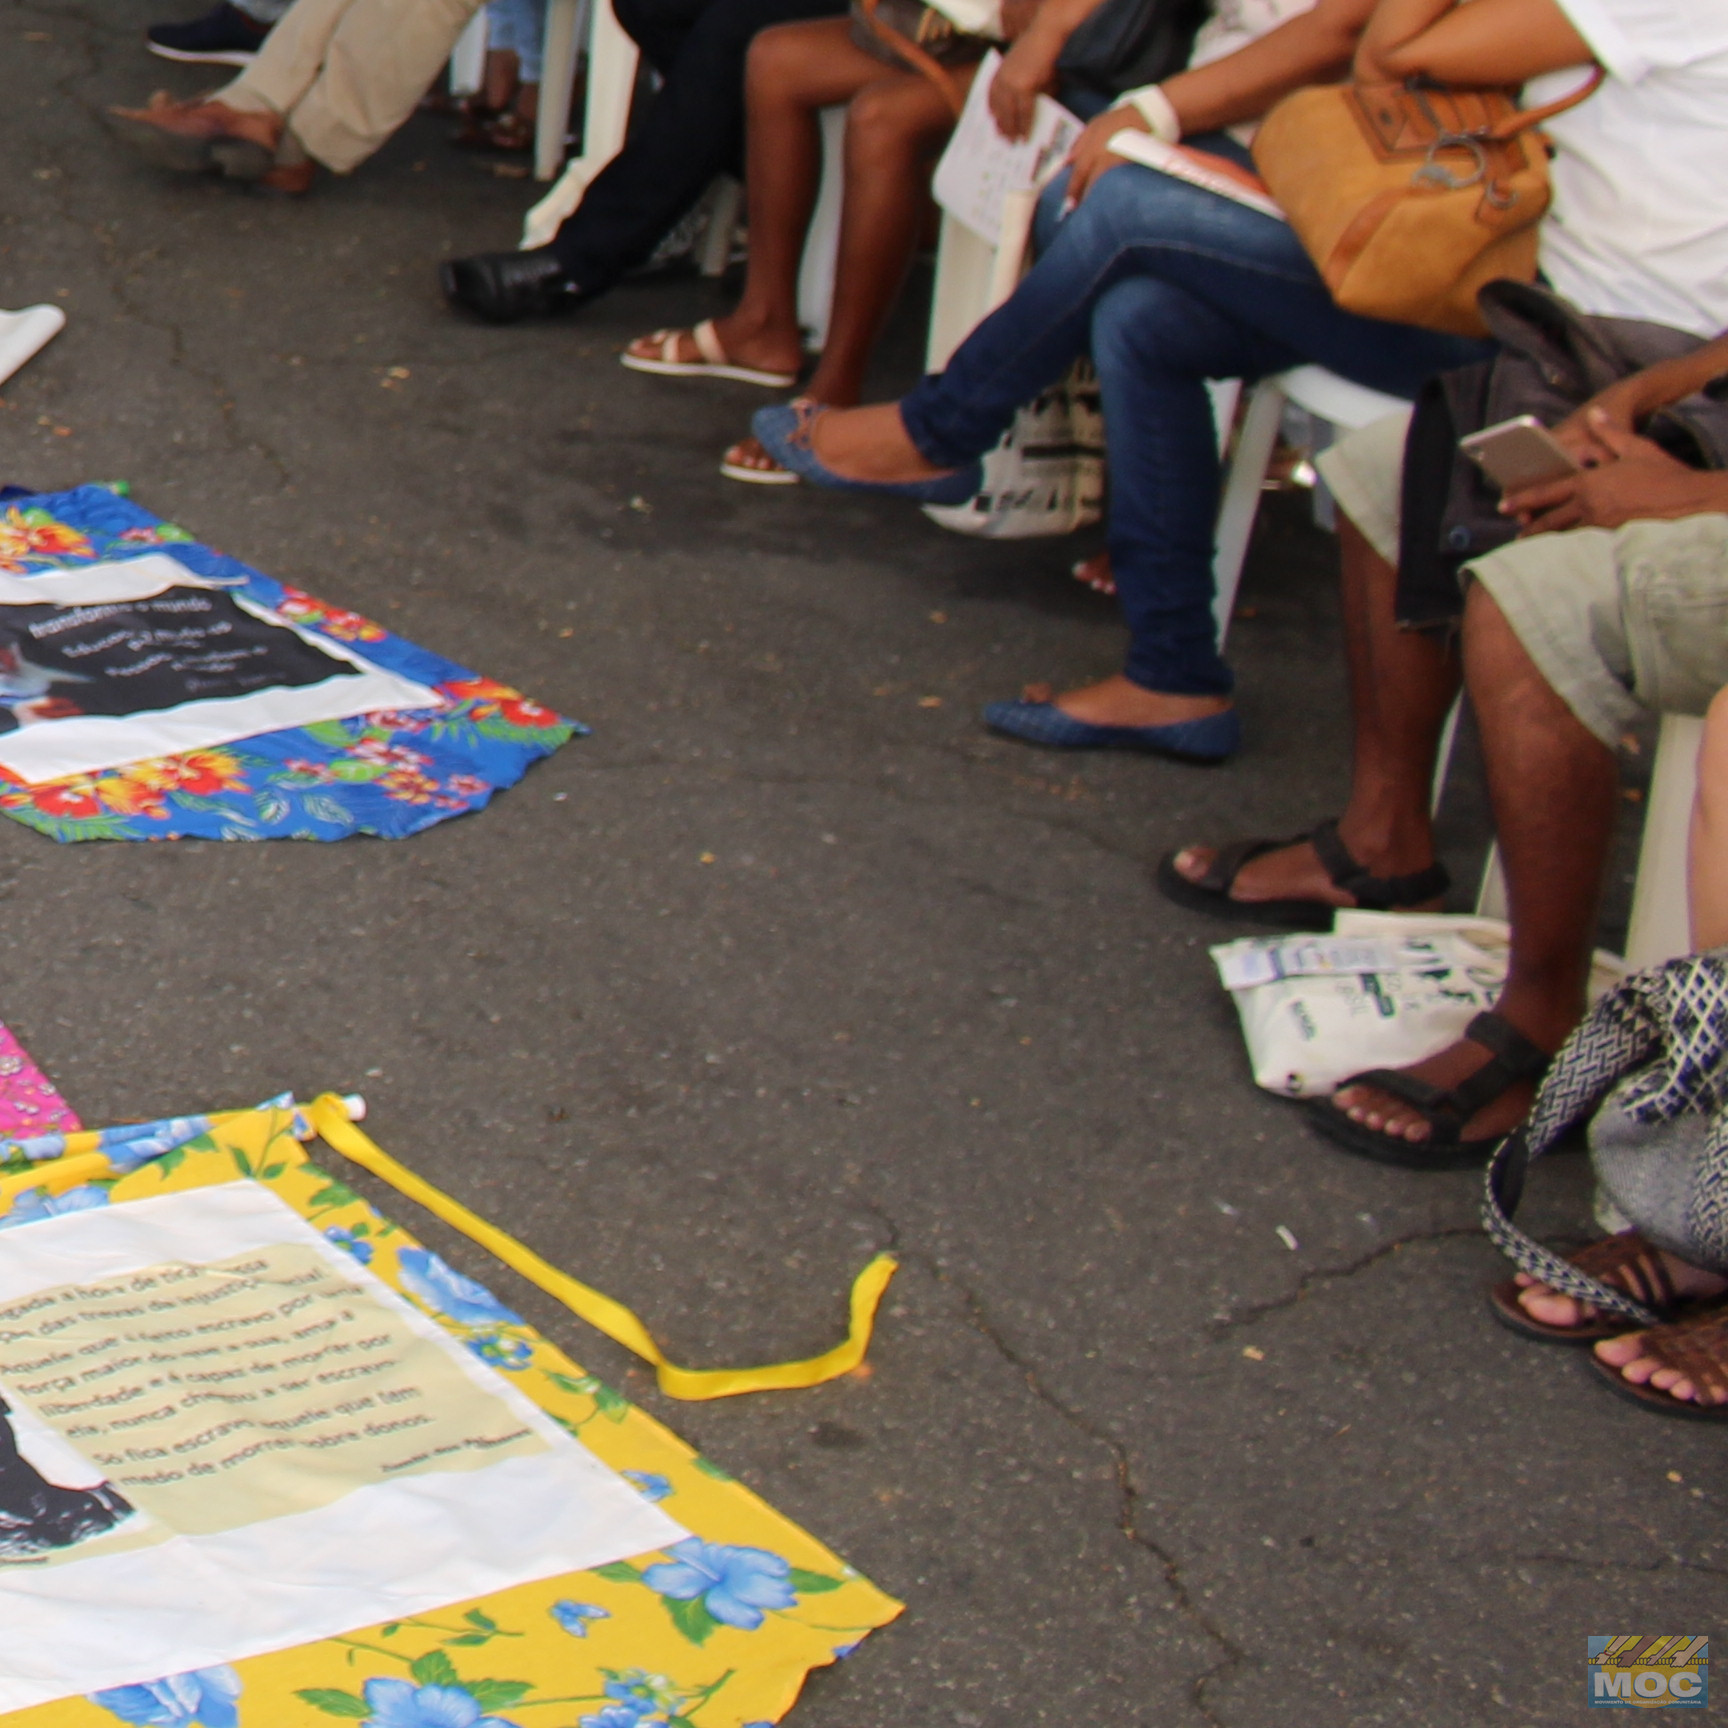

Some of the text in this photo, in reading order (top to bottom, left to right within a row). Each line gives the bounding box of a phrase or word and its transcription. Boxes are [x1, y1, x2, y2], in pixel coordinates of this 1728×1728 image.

[77, 1336, 120, 1358] que
[196, 1309, 276, 1336] escravo
[278, 1292, 314, 1319] por
[16, 1375, 77, 1398] força
[80, 1354, 143, 1383] maior
[37, 1382, 144, 1417] liberdade
[356, 1332, 393, 1354] por
[109, 1404, 179, 1431] nunca
[124, 1444, 170, 1464] fica
[333, 1394, 376, 1418] que
[186, 1460, 218, 1477] de
